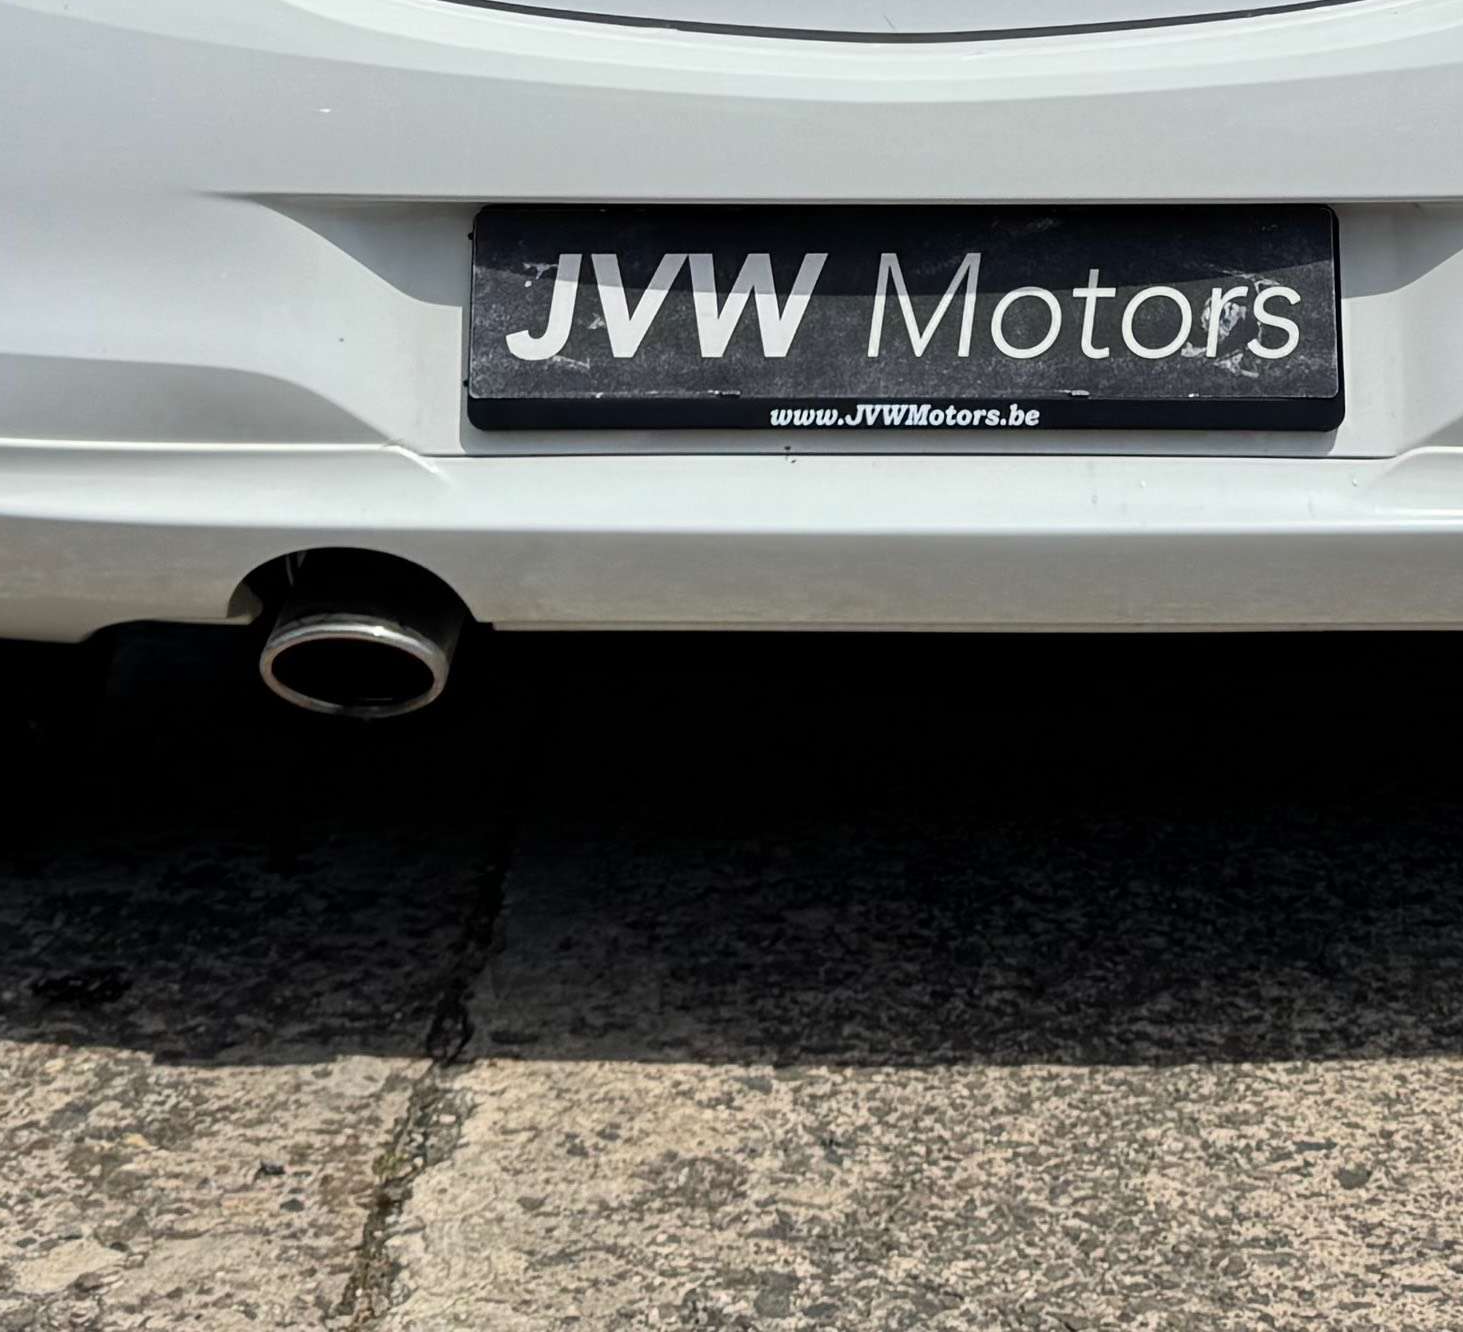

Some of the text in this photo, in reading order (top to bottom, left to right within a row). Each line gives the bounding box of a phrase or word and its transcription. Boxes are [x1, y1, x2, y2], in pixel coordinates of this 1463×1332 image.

[505, 253, 1301, 361] JVW Motors
[770, 403, 1040, 427] www.JVWMotors.be
